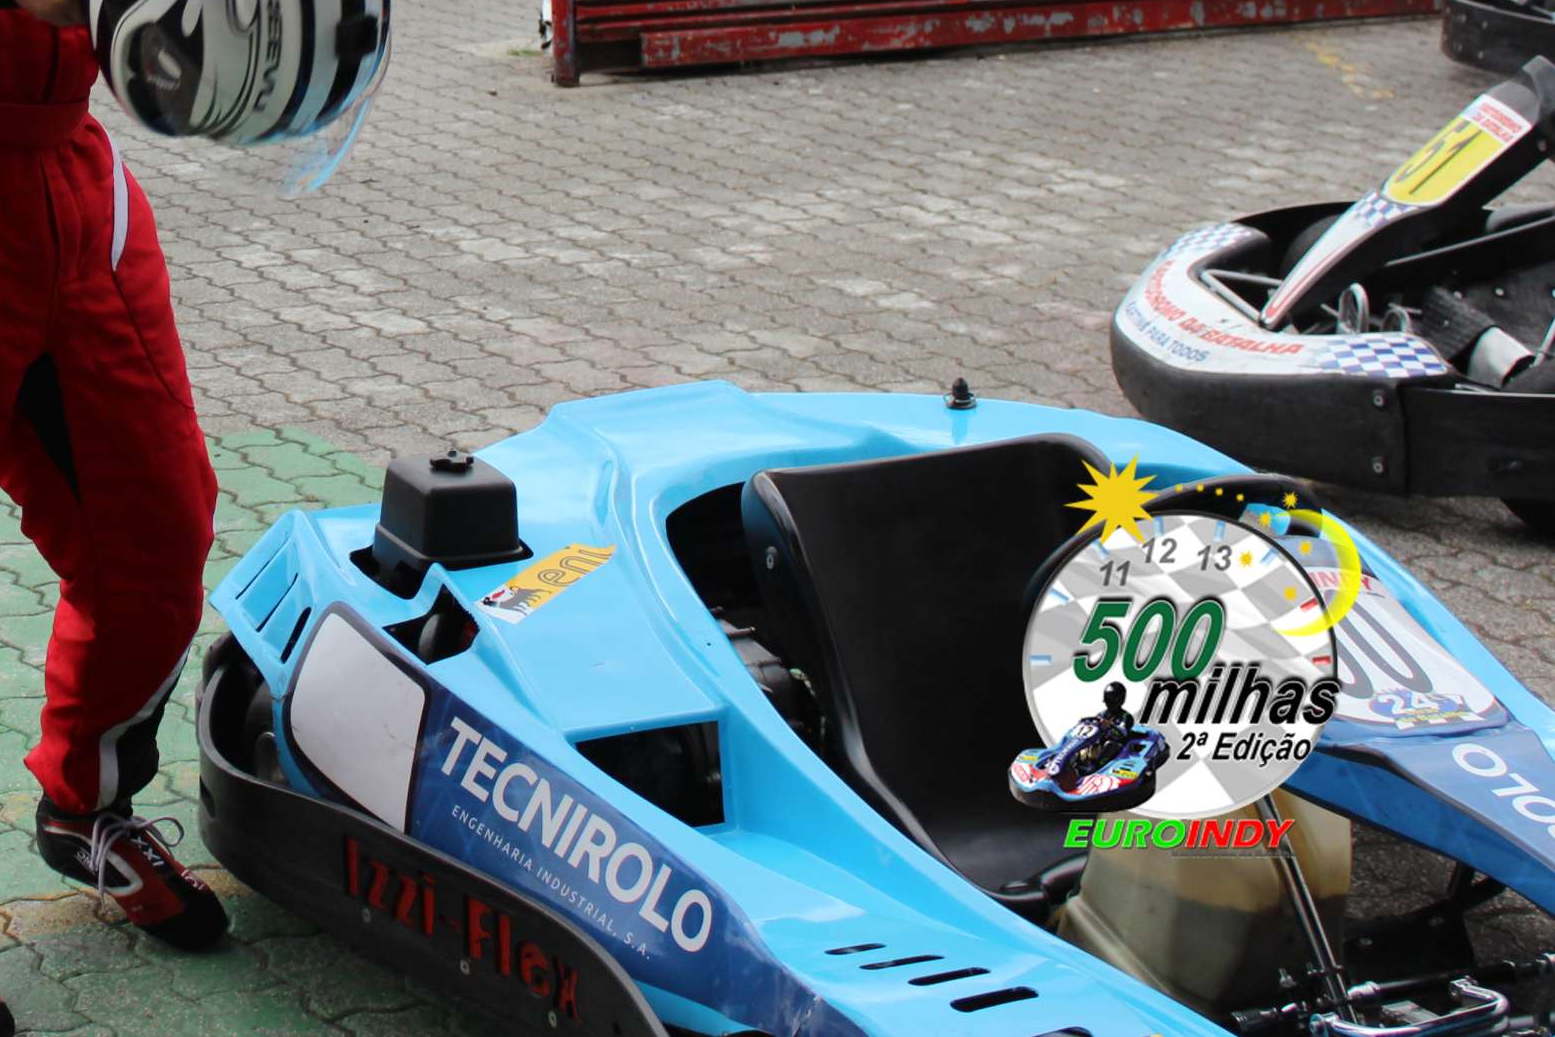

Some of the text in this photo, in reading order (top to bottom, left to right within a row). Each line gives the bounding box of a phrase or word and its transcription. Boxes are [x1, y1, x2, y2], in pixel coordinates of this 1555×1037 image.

[537, 546, 613, 587] eni
[441, 715, 713, 953] TECNIROLO
[451, 805, 652, 961] ENGENHARIA INDUSTRIAL, S.A.
